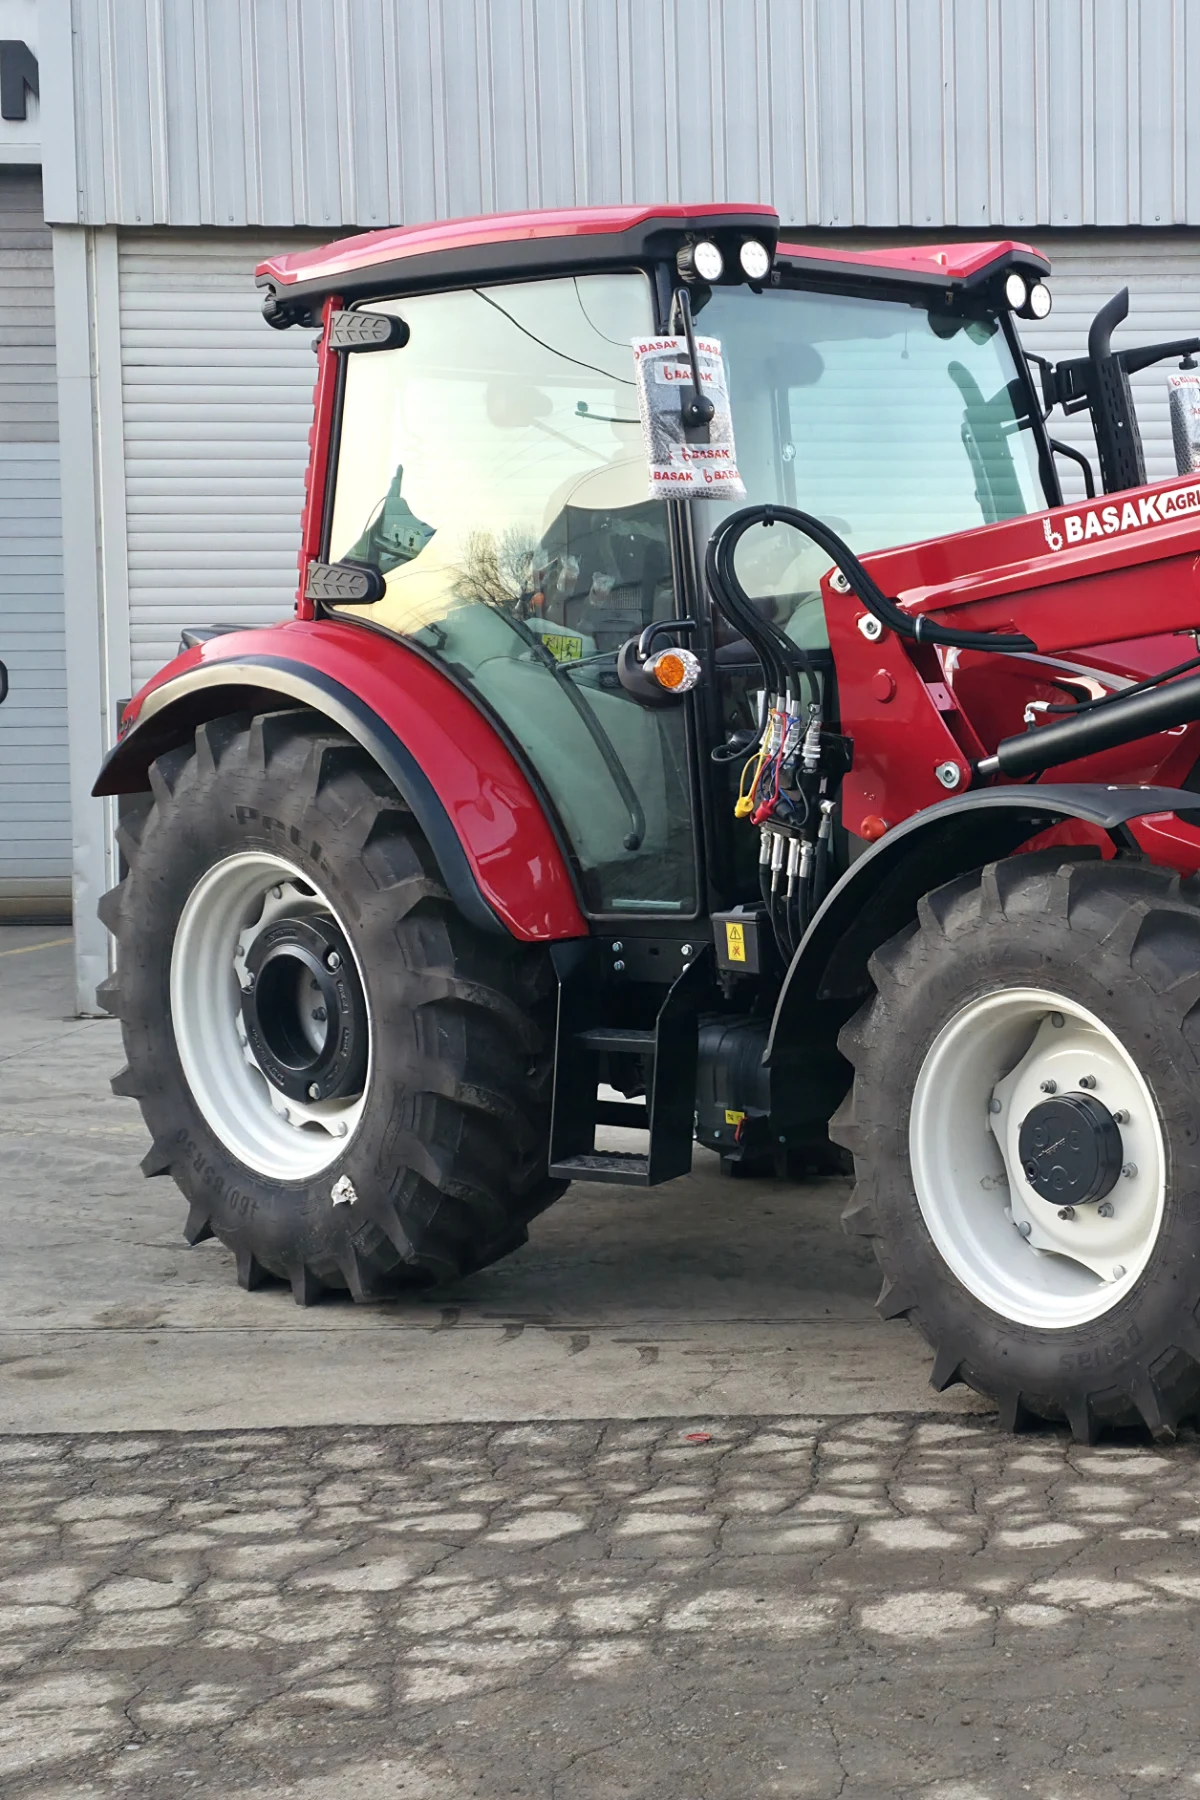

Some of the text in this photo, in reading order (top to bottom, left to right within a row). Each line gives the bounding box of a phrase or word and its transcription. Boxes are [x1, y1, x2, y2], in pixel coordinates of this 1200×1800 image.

[674, 370, 713, 381] BAAK
[692, 449, 730, 459] BASAK
[654, 471, 693, 481] BASAK
[1064, 495, 1161, 543] BASAK
